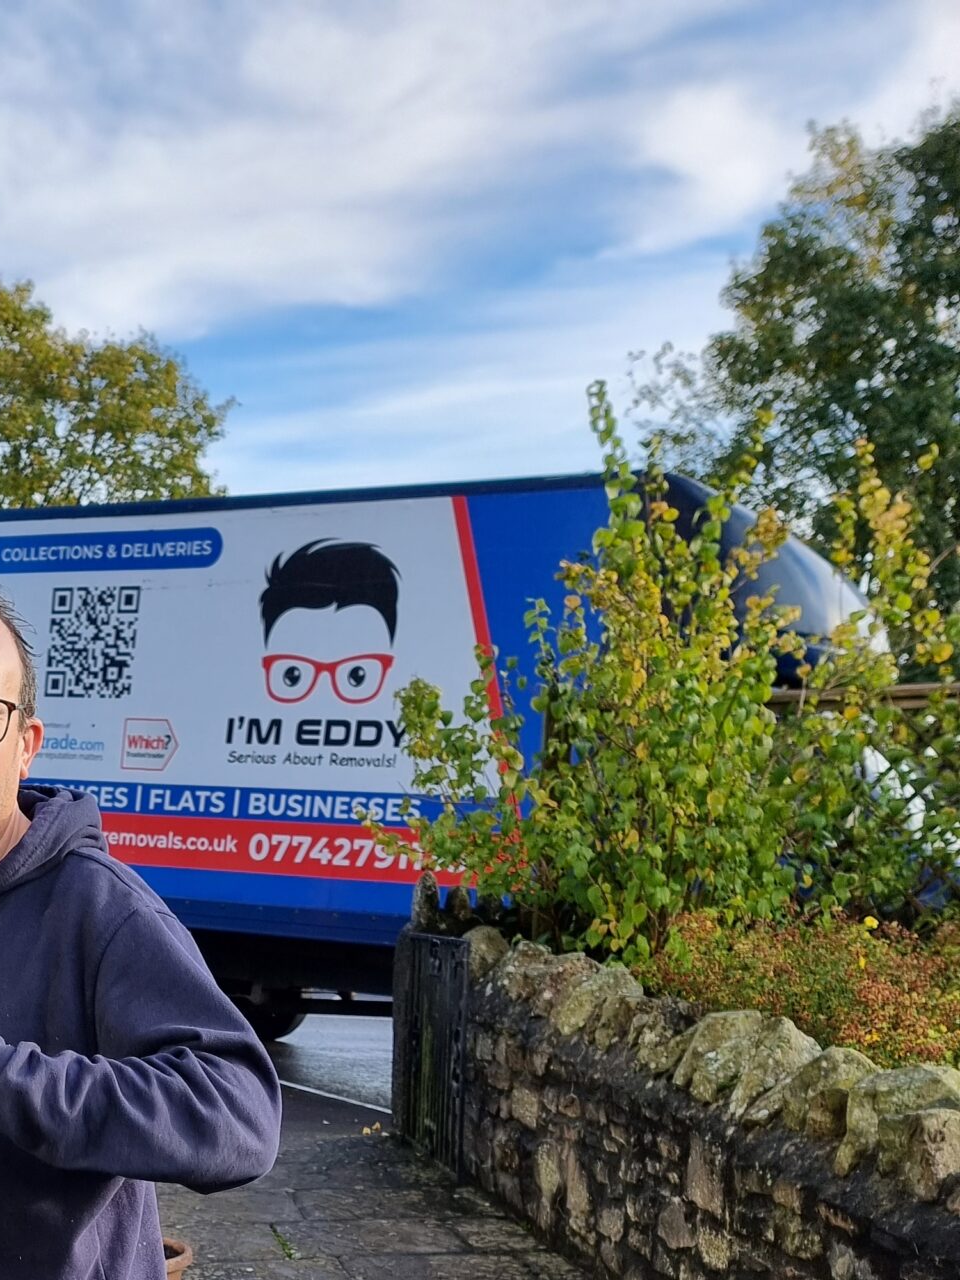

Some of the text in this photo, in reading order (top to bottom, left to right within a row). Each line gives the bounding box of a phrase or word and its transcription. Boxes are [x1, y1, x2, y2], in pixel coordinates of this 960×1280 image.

[0, 540, 213, 562] COLLECTIONS & DELIVERIES
[127, 735, 171, 750] Which?
[225, 716, 407, 748] I'M EDDY
[227, 750, 397, 768] Serious About Removals!
[148, 788, 225, 813] FLATS
[248, 793, 421, 822] BUSINESSES
